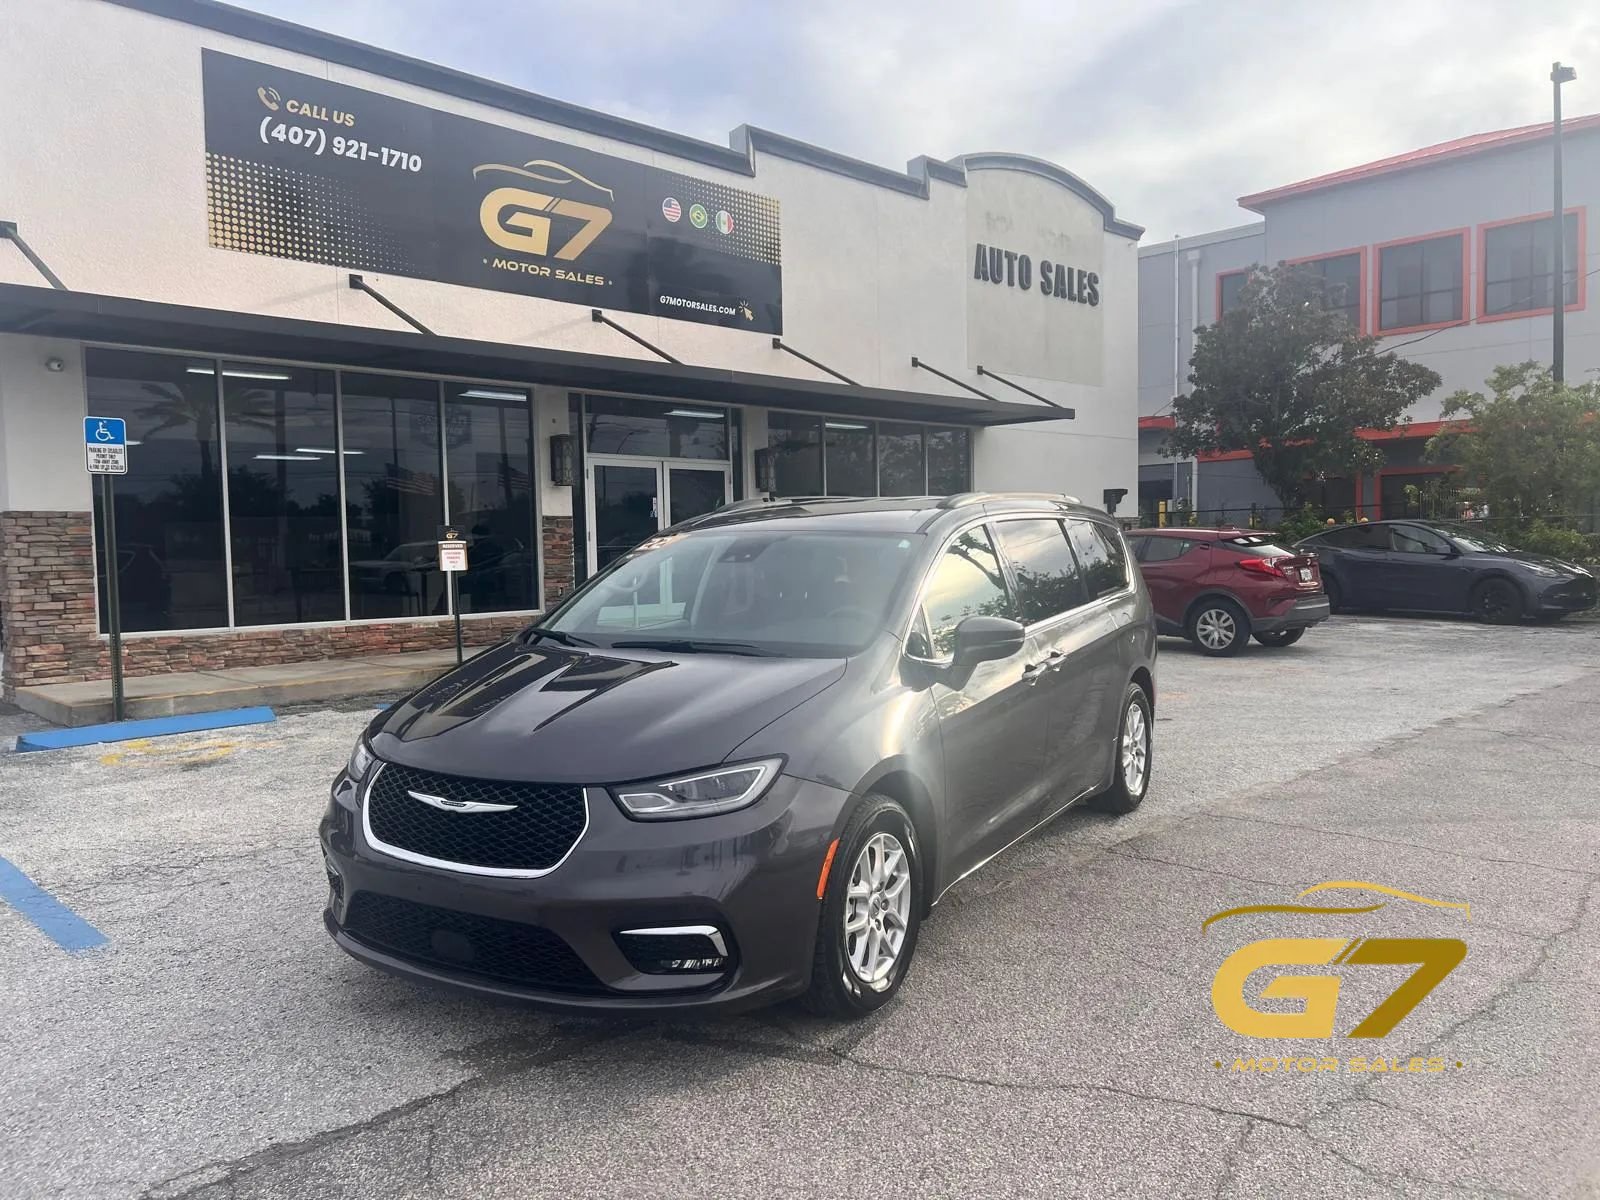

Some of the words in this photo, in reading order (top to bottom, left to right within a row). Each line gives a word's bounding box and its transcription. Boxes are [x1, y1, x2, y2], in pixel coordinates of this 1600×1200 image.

[286, 99, 329, 121] CALL
[333, 110, 355, 127] US
[260, 116, 327, 156] (407)
[332, 136, 422, 172] 921-1710
[480, 187, 613, 261] G7
[492, 258, 551, 277] MOTOR
[555, 269, 605, 286] SALES
[974, 243, 1032, 291] AUTO
[1040, 260, 1100, 307] SALES
[660, 295, 736, 316] G7MOTORSALES.COM
